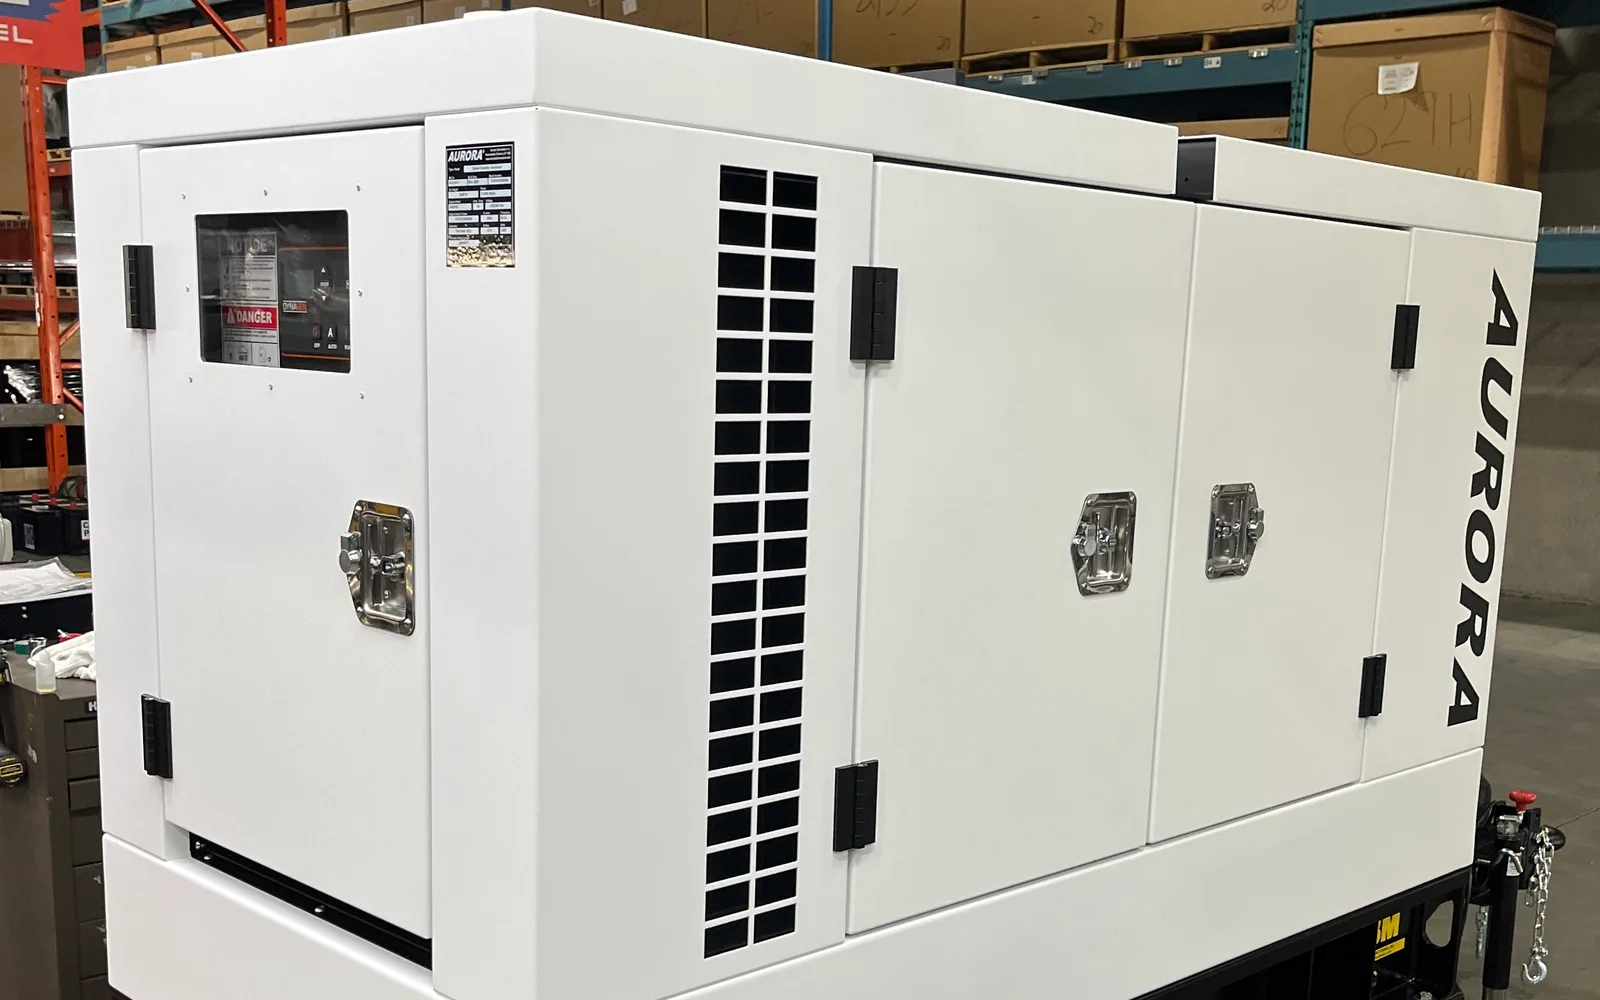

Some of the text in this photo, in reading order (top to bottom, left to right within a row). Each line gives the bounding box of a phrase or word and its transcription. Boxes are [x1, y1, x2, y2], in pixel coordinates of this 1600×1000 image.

[447, 149, 483, 162] AURORA
[236, 310, 272, 324] DANGER
[1447, 267, 1519, 727] AURORA
